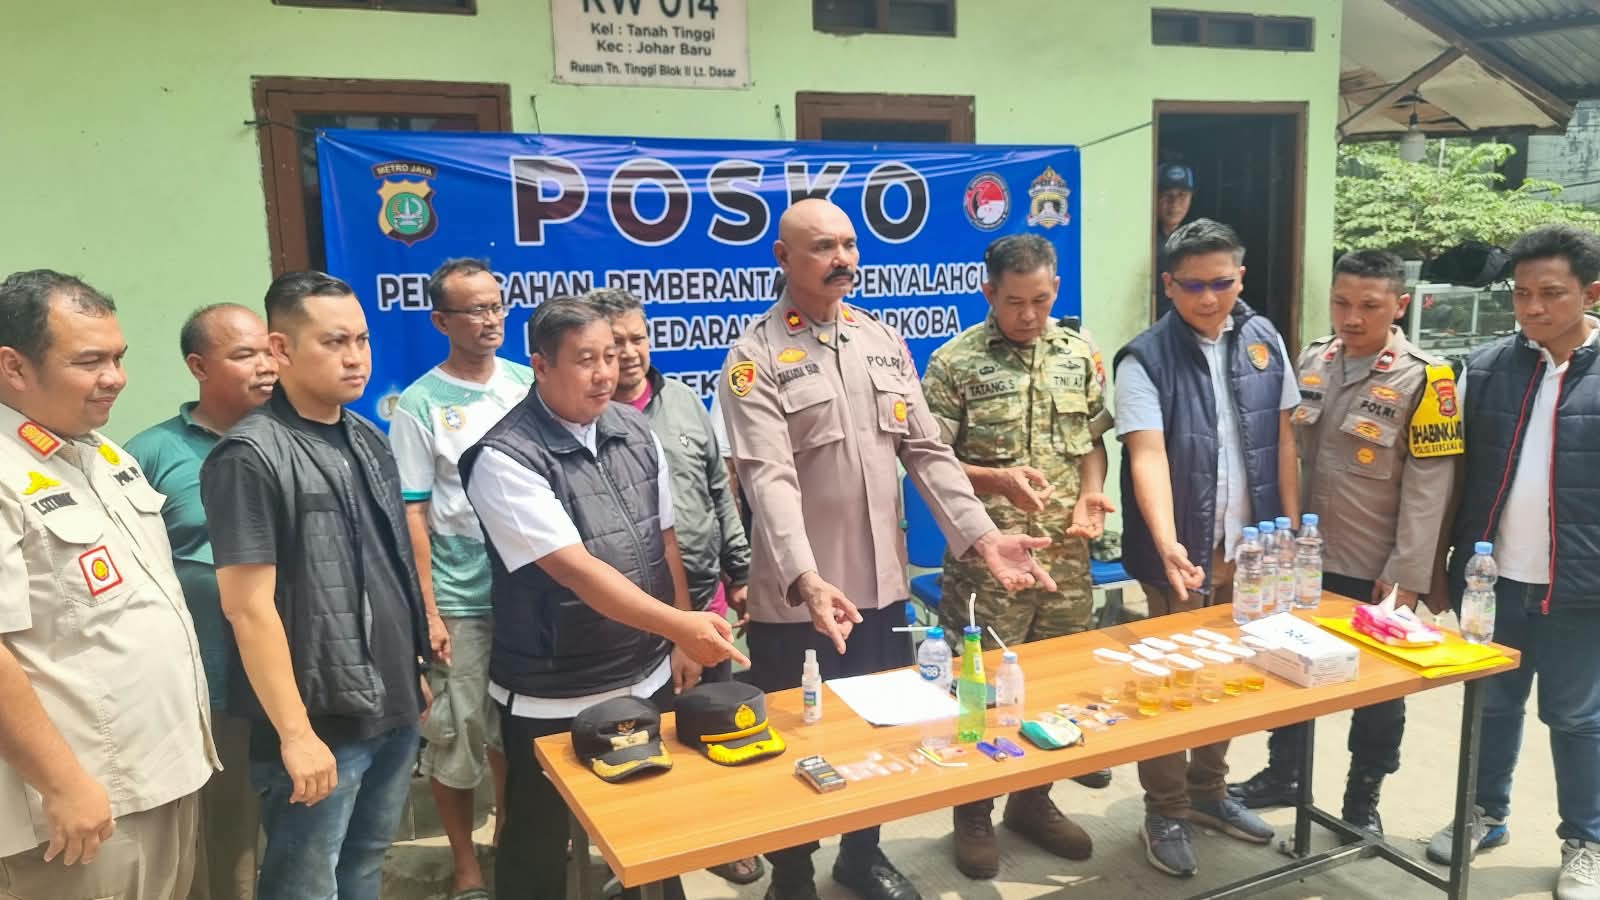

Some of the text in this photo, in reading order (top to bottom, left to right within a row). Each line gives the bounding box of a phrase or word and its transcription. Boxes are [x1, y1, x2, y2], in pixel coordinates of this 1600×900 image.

[591, 22, 614, 35] Kel
[627, 24, 668, 38] Tanah
[672, 26, 715, 42] Tinggi
[597, 40, 624, 53] Kec
[636, 41, 675, 55] Johar
[680, 43, 712, 57] Baru
[570, 60, 603, 73] Rusun
[606, 61, 621, 74] Tn.
[625, 62, 657, 77] Tinggi
[659, 64, 683, 76] Blok
[693, 66, 706, 77] Lt.
[709, 66, 736, 78] Dasar
[376, 263, 987, 311] PENAHAN PEMBERANTA PENYALAHG
[871, 307, 961, 338] RKOBA
[1361, 400, 1397, 419] POLRI
